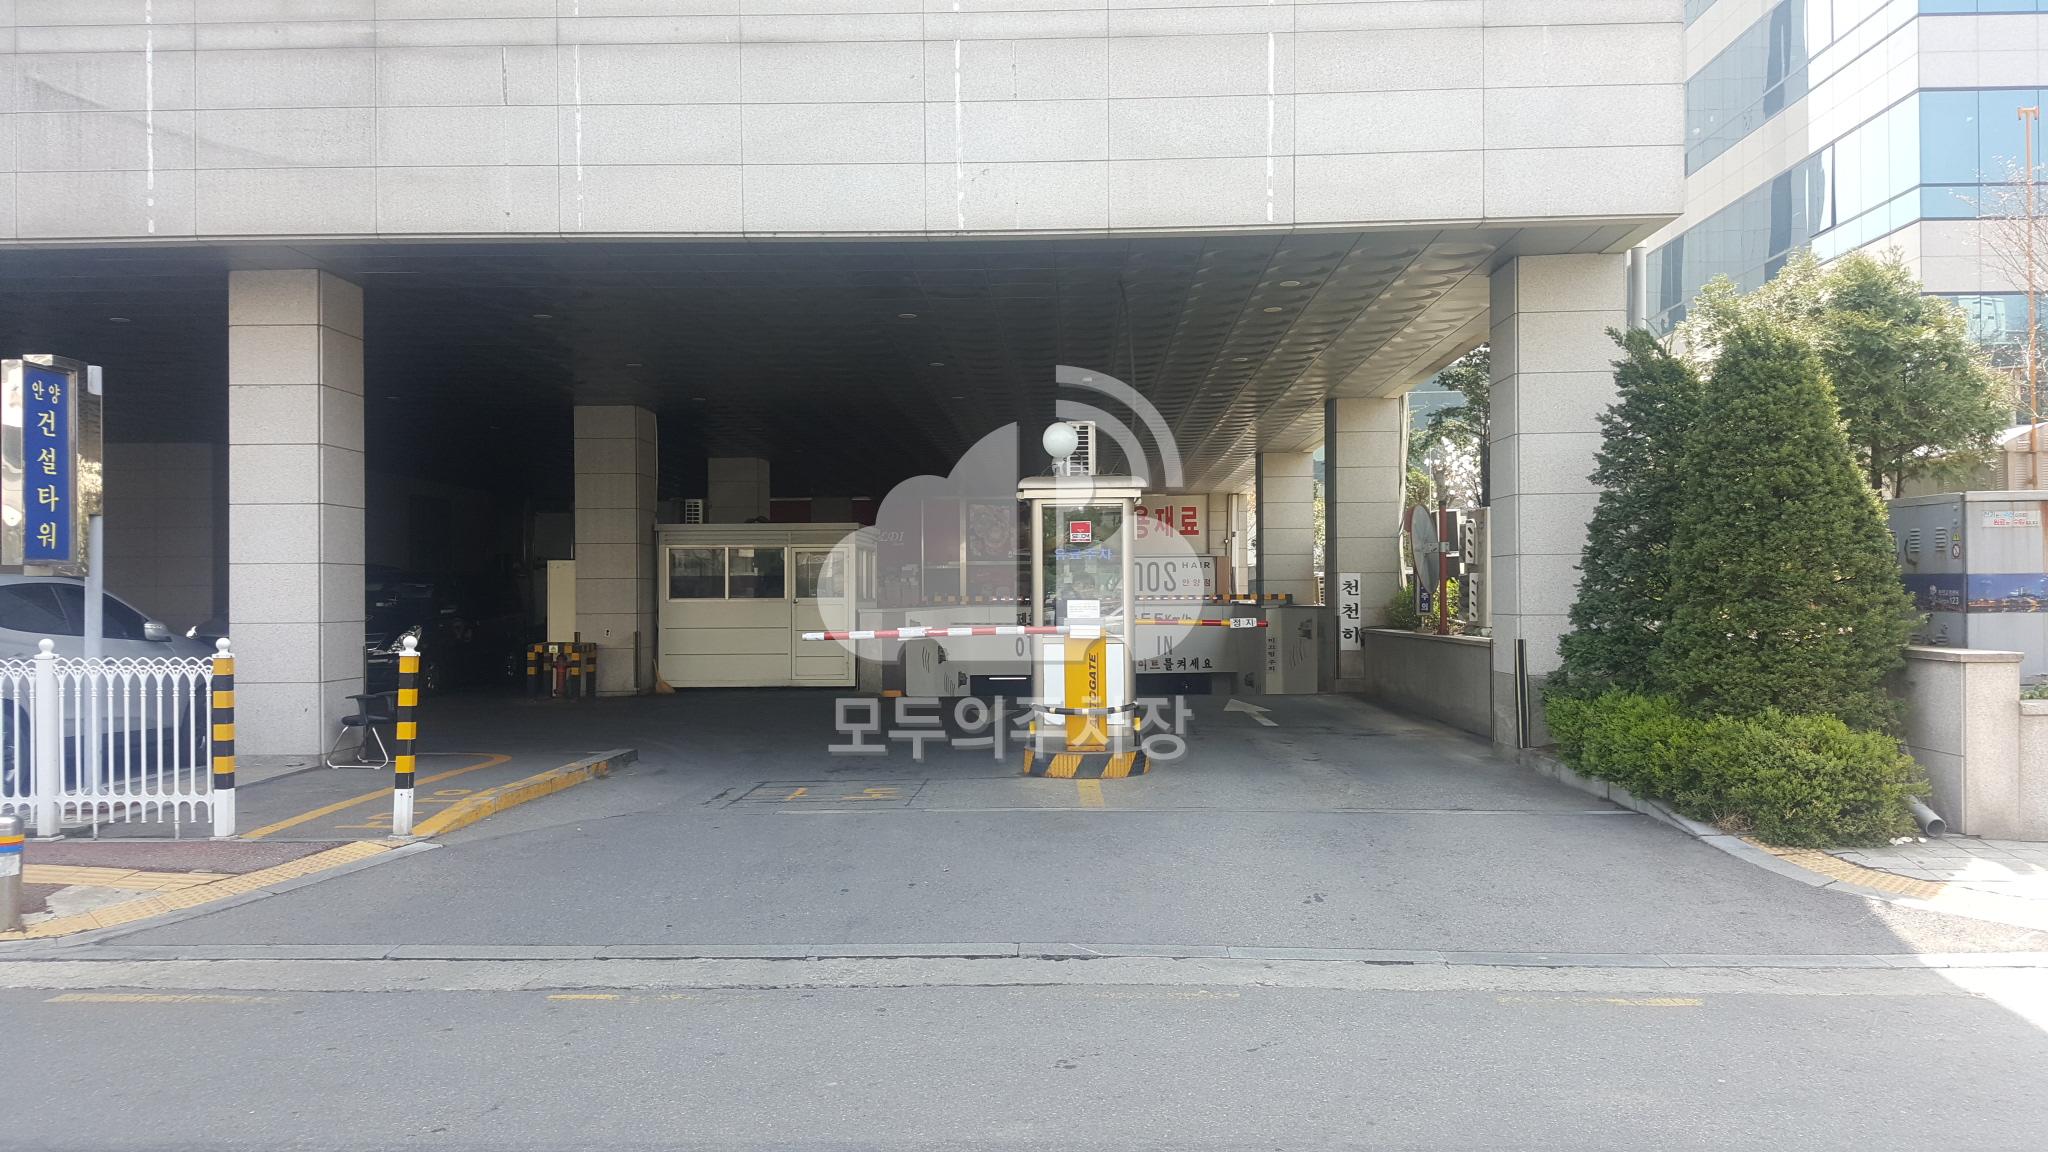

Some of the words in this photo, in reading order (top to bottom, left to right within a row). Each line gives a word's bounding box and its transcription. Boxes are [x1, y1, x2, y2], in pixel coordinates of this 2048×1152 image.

[32, 380, 61, 404] 안양
[37, 410, 59, 549] 건설타워
[1341, 579, 1361, 643] 천천히
[1157, 635, 1173, 655] IN
[1088, 652, 1098, 729] ATOGATE
